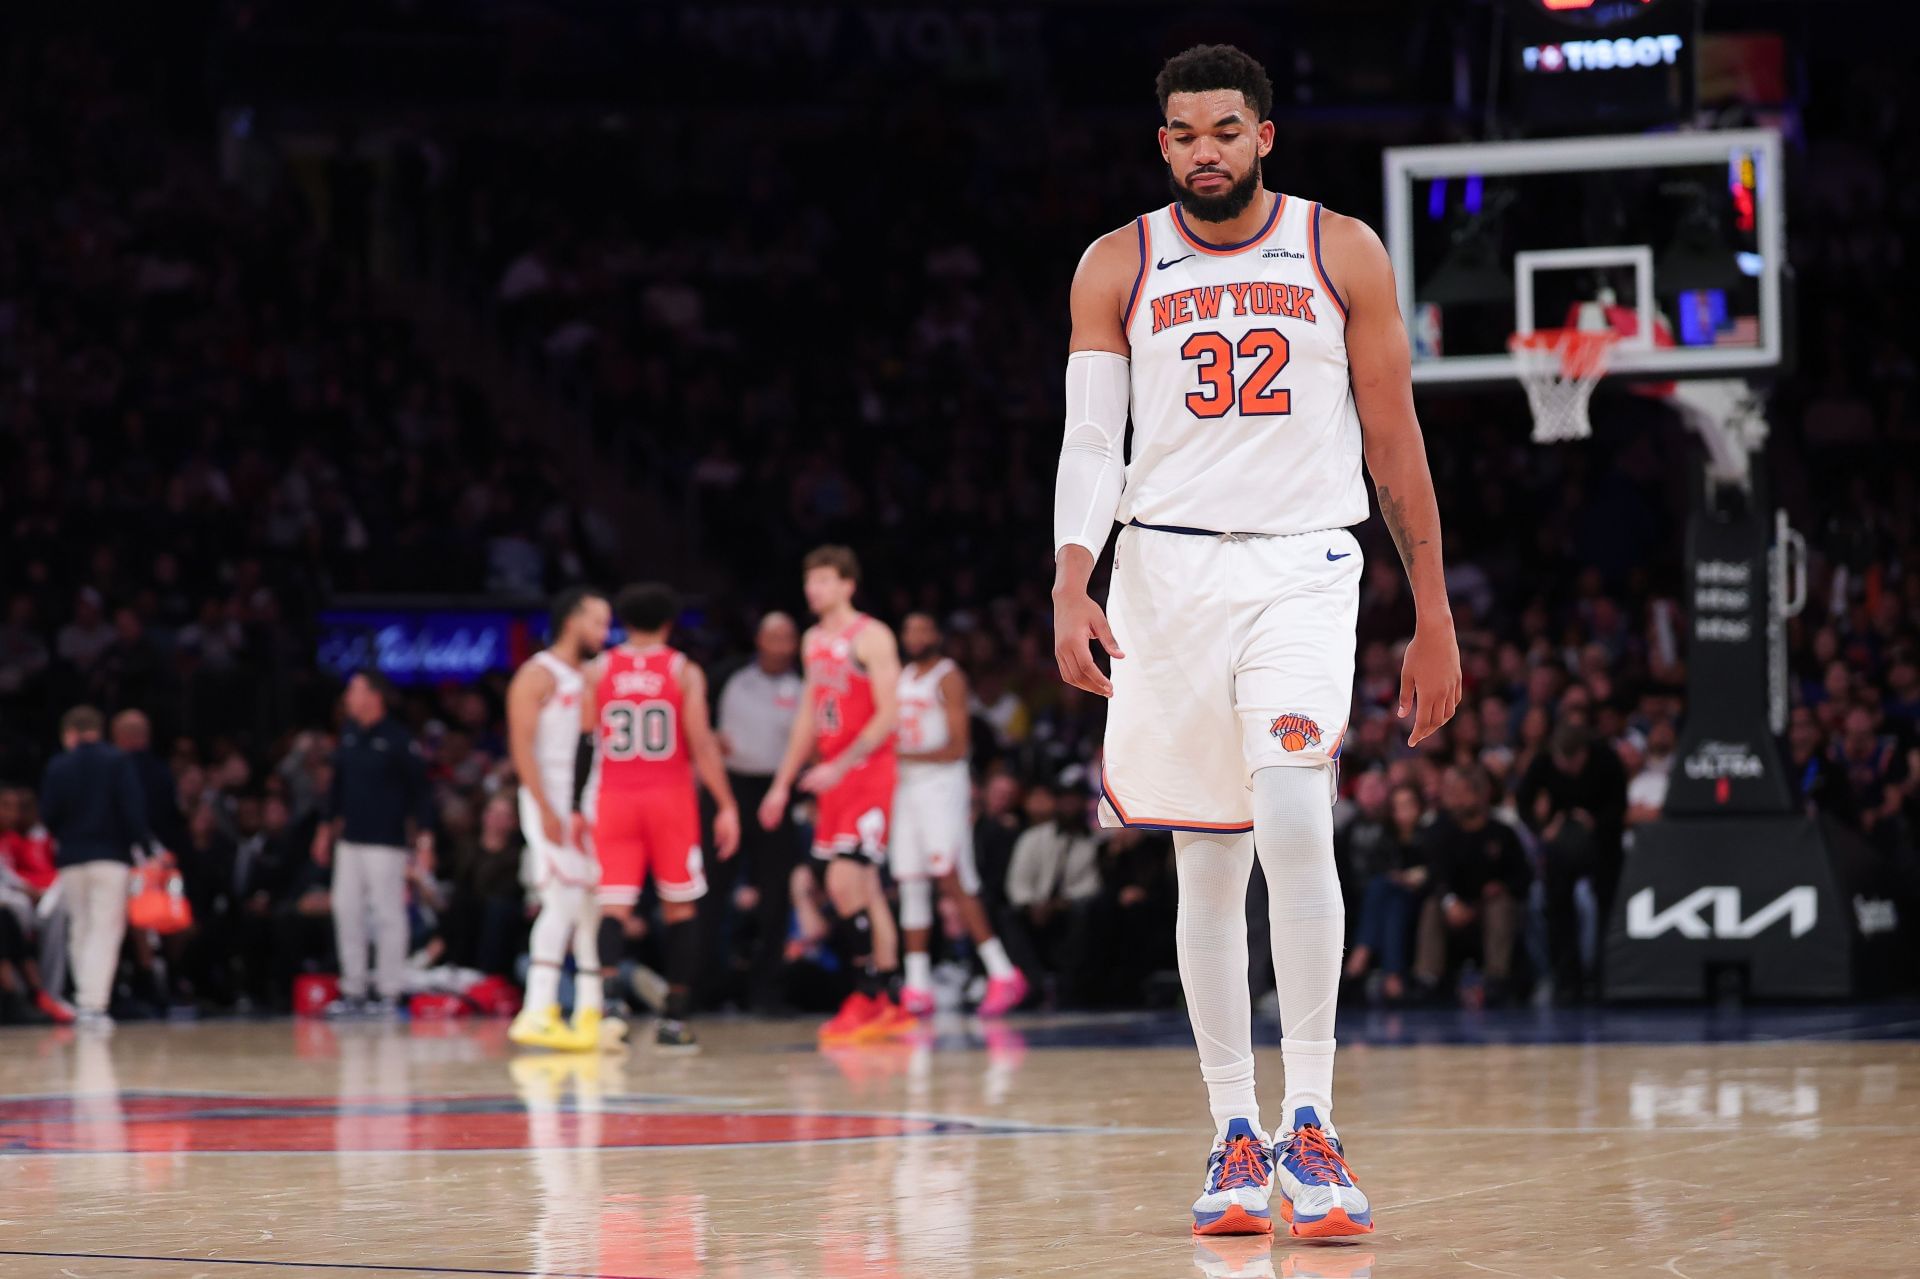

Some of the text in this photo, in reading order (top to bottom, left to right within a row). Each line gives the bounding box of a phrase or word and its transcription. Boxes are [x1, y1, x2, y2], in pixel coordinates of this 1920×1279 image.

[1561, 34, 1682, 71] TISSOT
[1280, 251, 1305, 259] dhabi
[1151, 281, 1317, 335] NEW YORK
[1180, 327, 1291, 419] 32
[601, 699, 677, 762] 30
[1269, 713, 1321, 747] KNICKS
[1684, 753, 1763, 779] ULTRA
[1626, 886, 1818, 939] KIA
